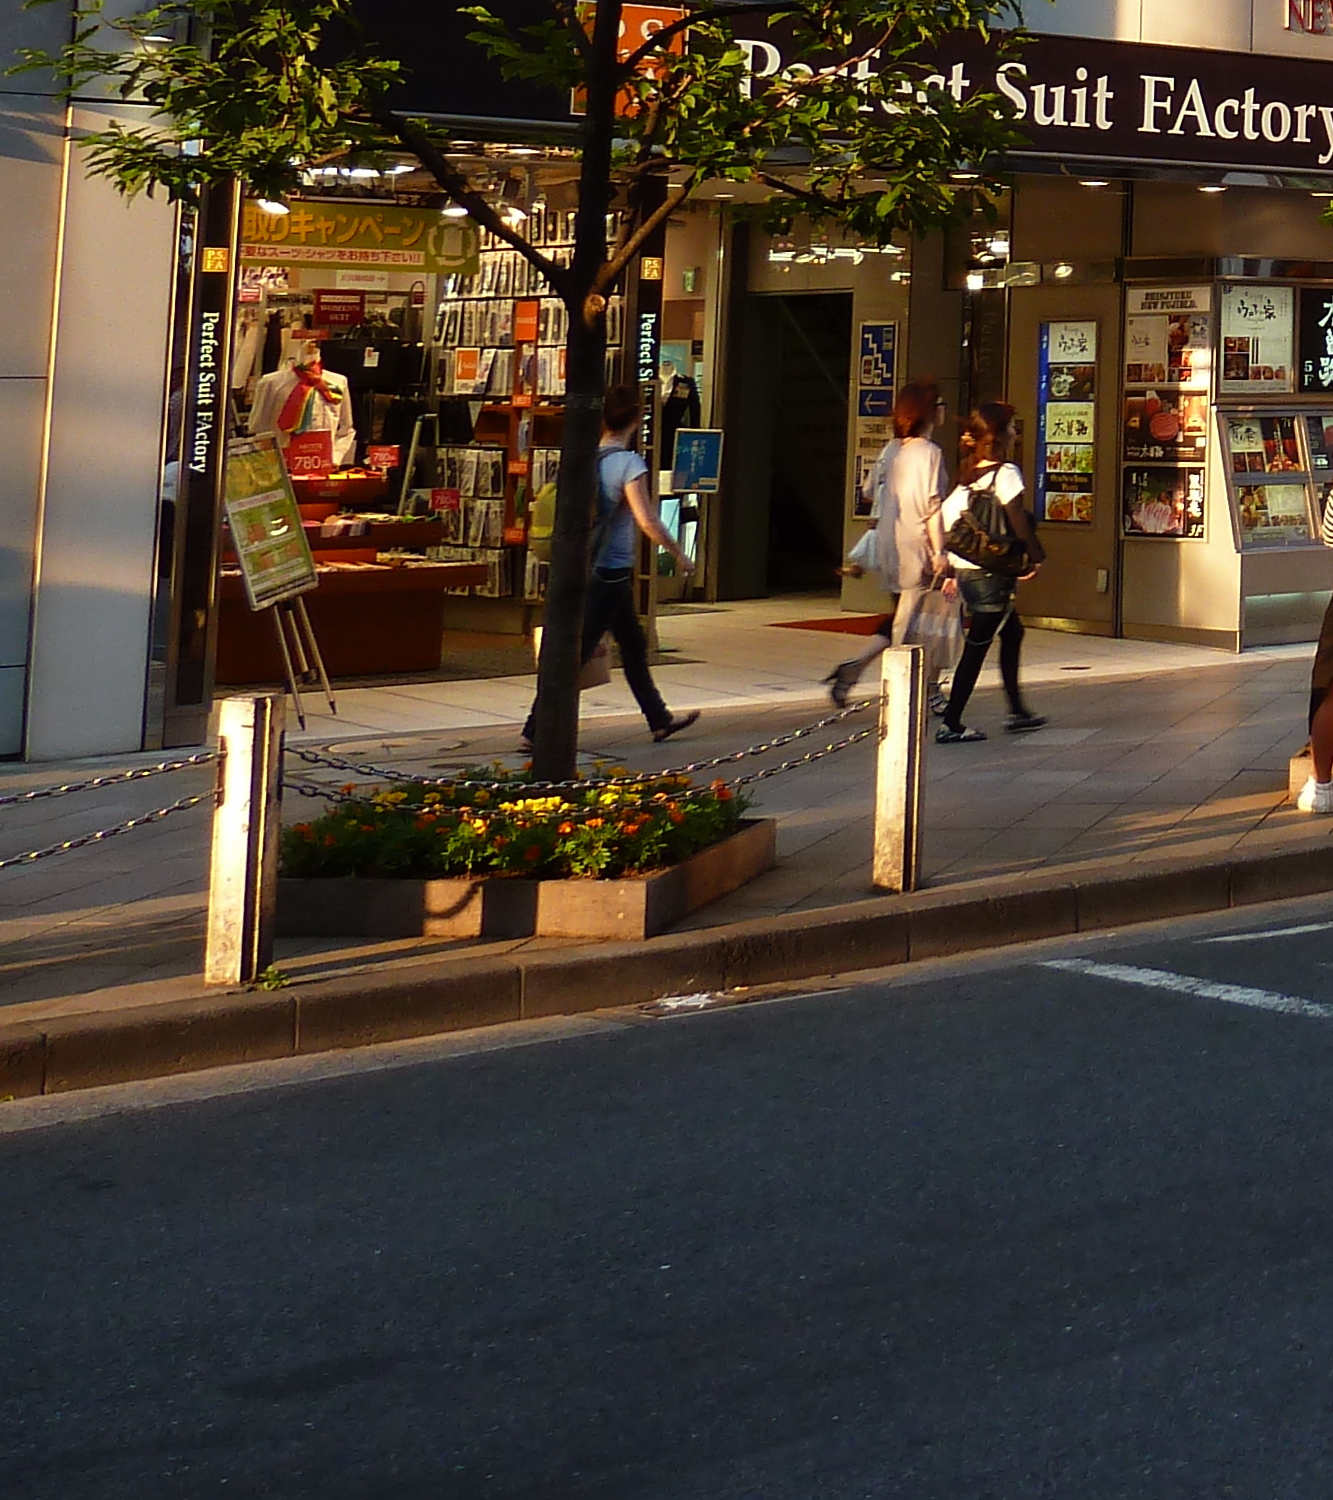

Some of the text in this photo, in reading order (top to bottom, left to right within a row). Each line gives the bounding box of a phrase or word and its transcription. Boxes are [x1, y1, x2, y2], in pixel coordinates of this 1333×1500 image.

[993, 62, 1115, 131] Suit
[640, 313, 657, 365] Perfect
[188, 311, 220, 474] Perfect Suit FActory
[1303, 360, 1314, 386] 5F
[294, 456, 322, 470] 780
[373, 452, 391, 462] 780
